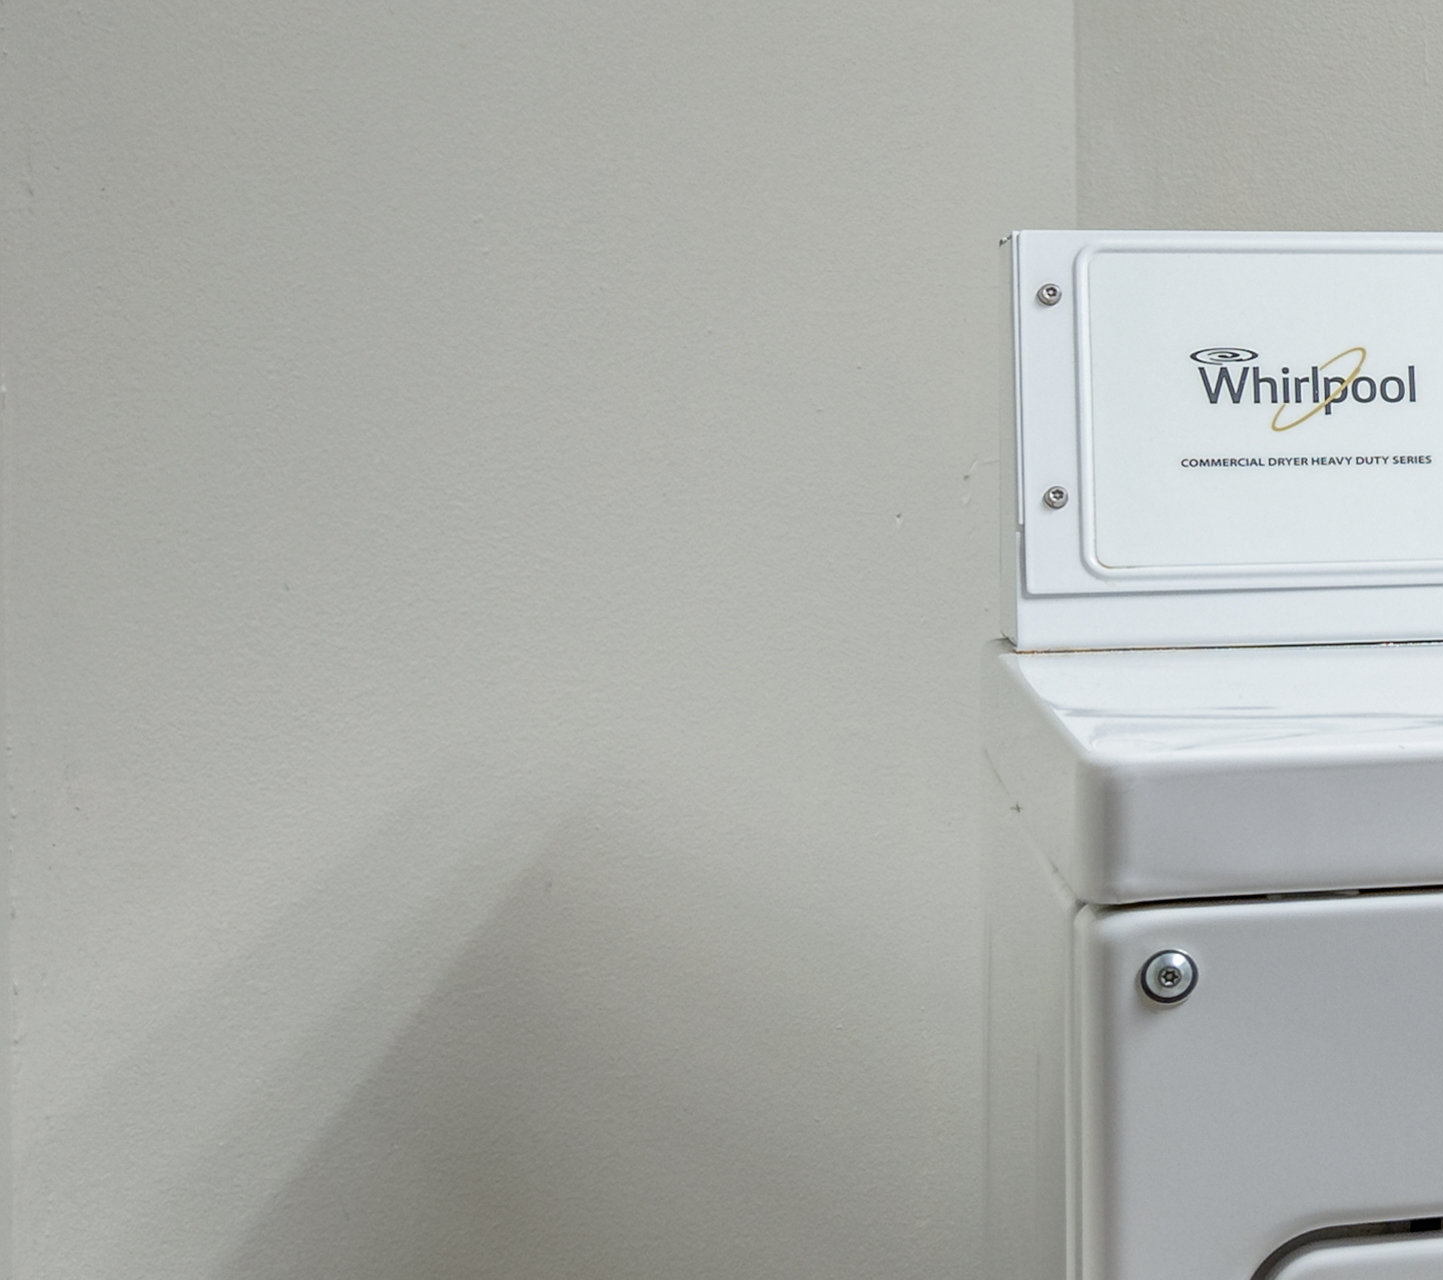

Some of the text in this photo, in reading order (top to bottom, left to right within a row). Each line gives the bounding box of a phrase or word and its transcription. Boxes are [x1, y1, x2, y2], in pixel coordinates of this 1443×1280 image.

[1199, 365, 1416, 415] Whirlpool
[1181, 455, 1432, 468] COMMERCIAL DRYER HEAVY DUTY SERIES
